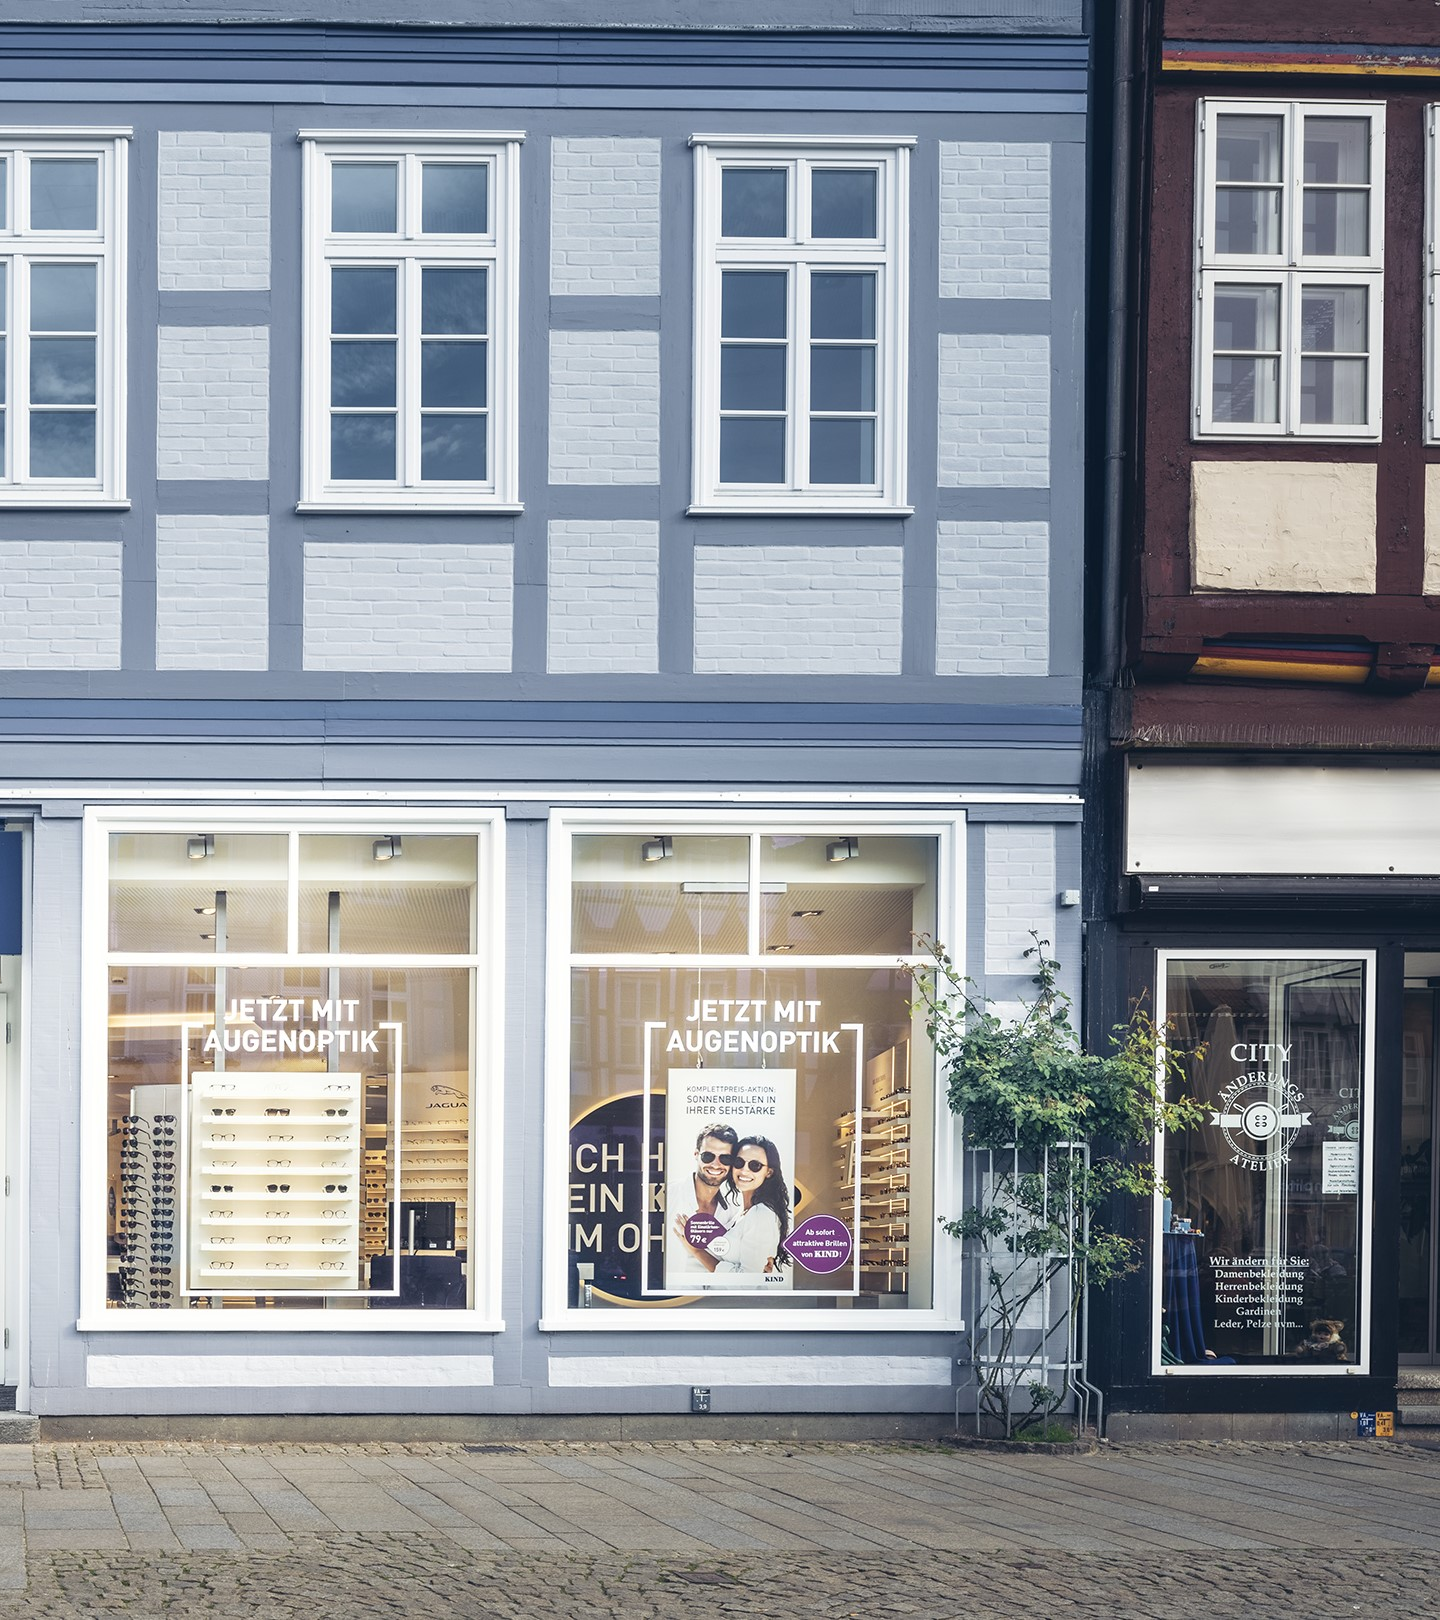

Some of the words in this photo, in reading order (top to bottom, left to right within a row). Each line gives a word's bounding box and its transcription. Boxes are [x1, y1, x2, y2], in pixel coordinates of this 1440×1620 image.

[223, 999, 303, 1022] JETZT
[311, 999, 360, 1022] MIT
[686, 1000, 766, 1023] JETZT
[773, 1000, 822, 1023] MIT
[203, 1029, 379, 1053] AUGENOPTIK
[665, 1029, 840, 1054] AUGENOPTIK
[1230, 1043, 1293, 1062] CITY
[1217, 1071, 1305, 1103] ÄNDERUNGS
[686, 1095, 764, 1104] SONNENBRILLEN
[766, 1095, 776, 1104] IN
[686, 1106, 716, 1115] IHRER
[718, 1104, 776, 1116] SEHSTÄRKE
[1229, 1153, 1292, 1172] ATELIER
[815, 1228, 836, 1236] sofort
[792, 1239, 824, 1247] attraktive
[825, 1239, 848, 1247] Brillen
[1209, 1256, 1230, 1266] Wir
[1231, 1256, 1268, 1266] ändern
[1289, 1255, 1310, 1266] Sie:
[1214, 1269, 1305, 1281] Damenbekleidung
[1214, 1281, 1304, 1293] Herrenbekleidung
[1214, 1294, 1304, 1306] Kinderbekleidung
[1235, 1306, 1282, 1316] Gardinen
[1213, 1319, 1244, 1330] Leder,
[1246, 1319, 1272, 1329] Pelze
